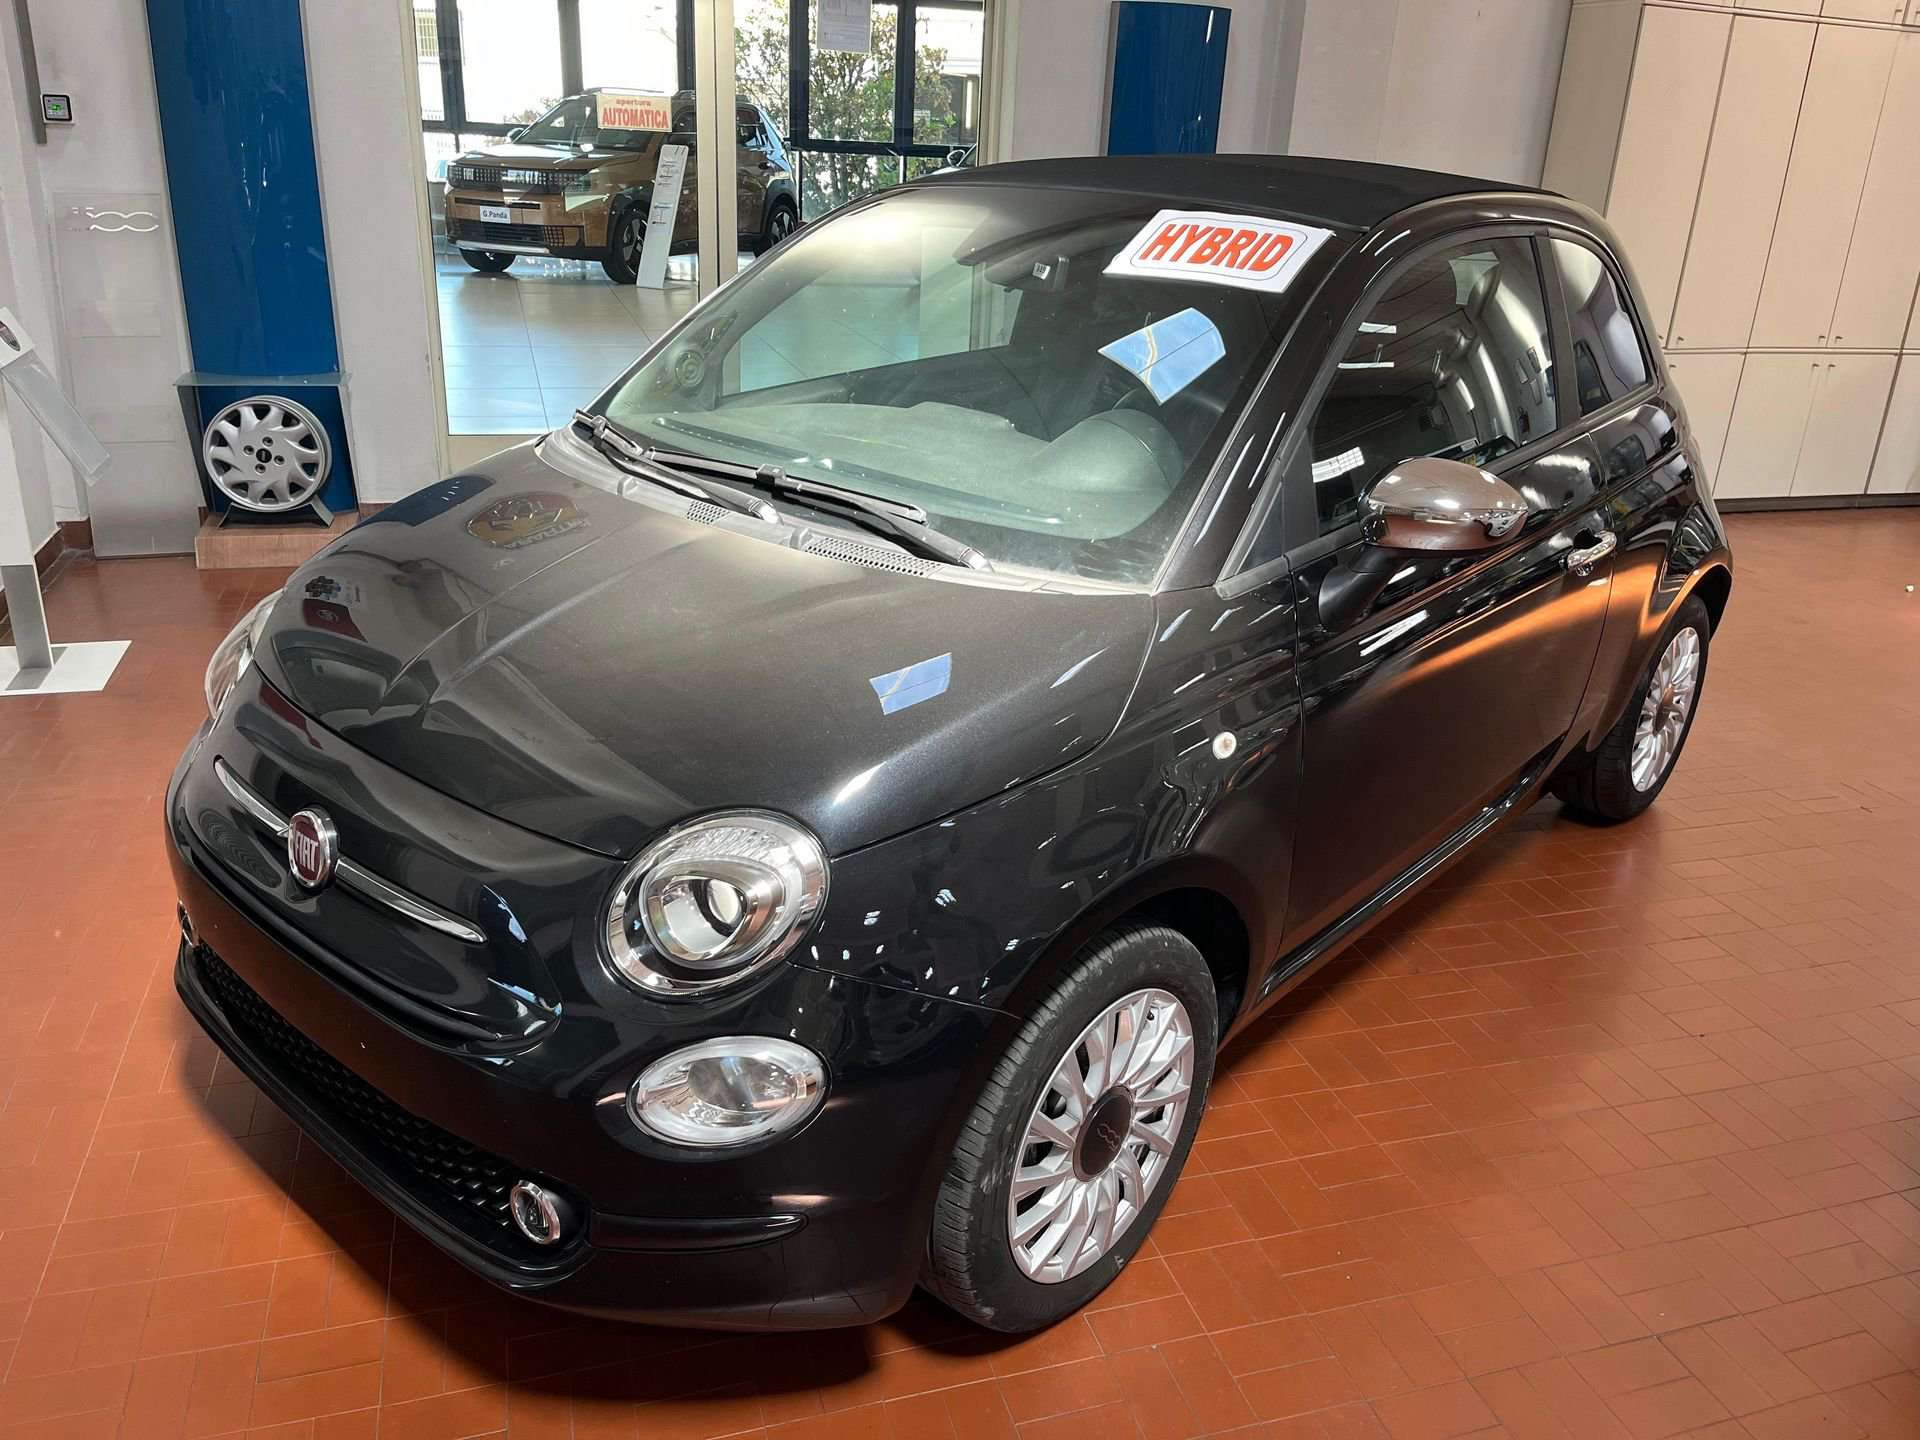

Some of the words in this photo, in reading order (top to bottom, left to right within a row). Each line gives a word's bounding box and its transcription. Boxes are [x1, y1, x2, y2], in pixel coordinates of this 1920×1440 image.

[602, 107, 669, 128] AUTOMATICA
[1138, 223, 1294, 272] HYBRID
[293, 829, 319, 872] FIAT
